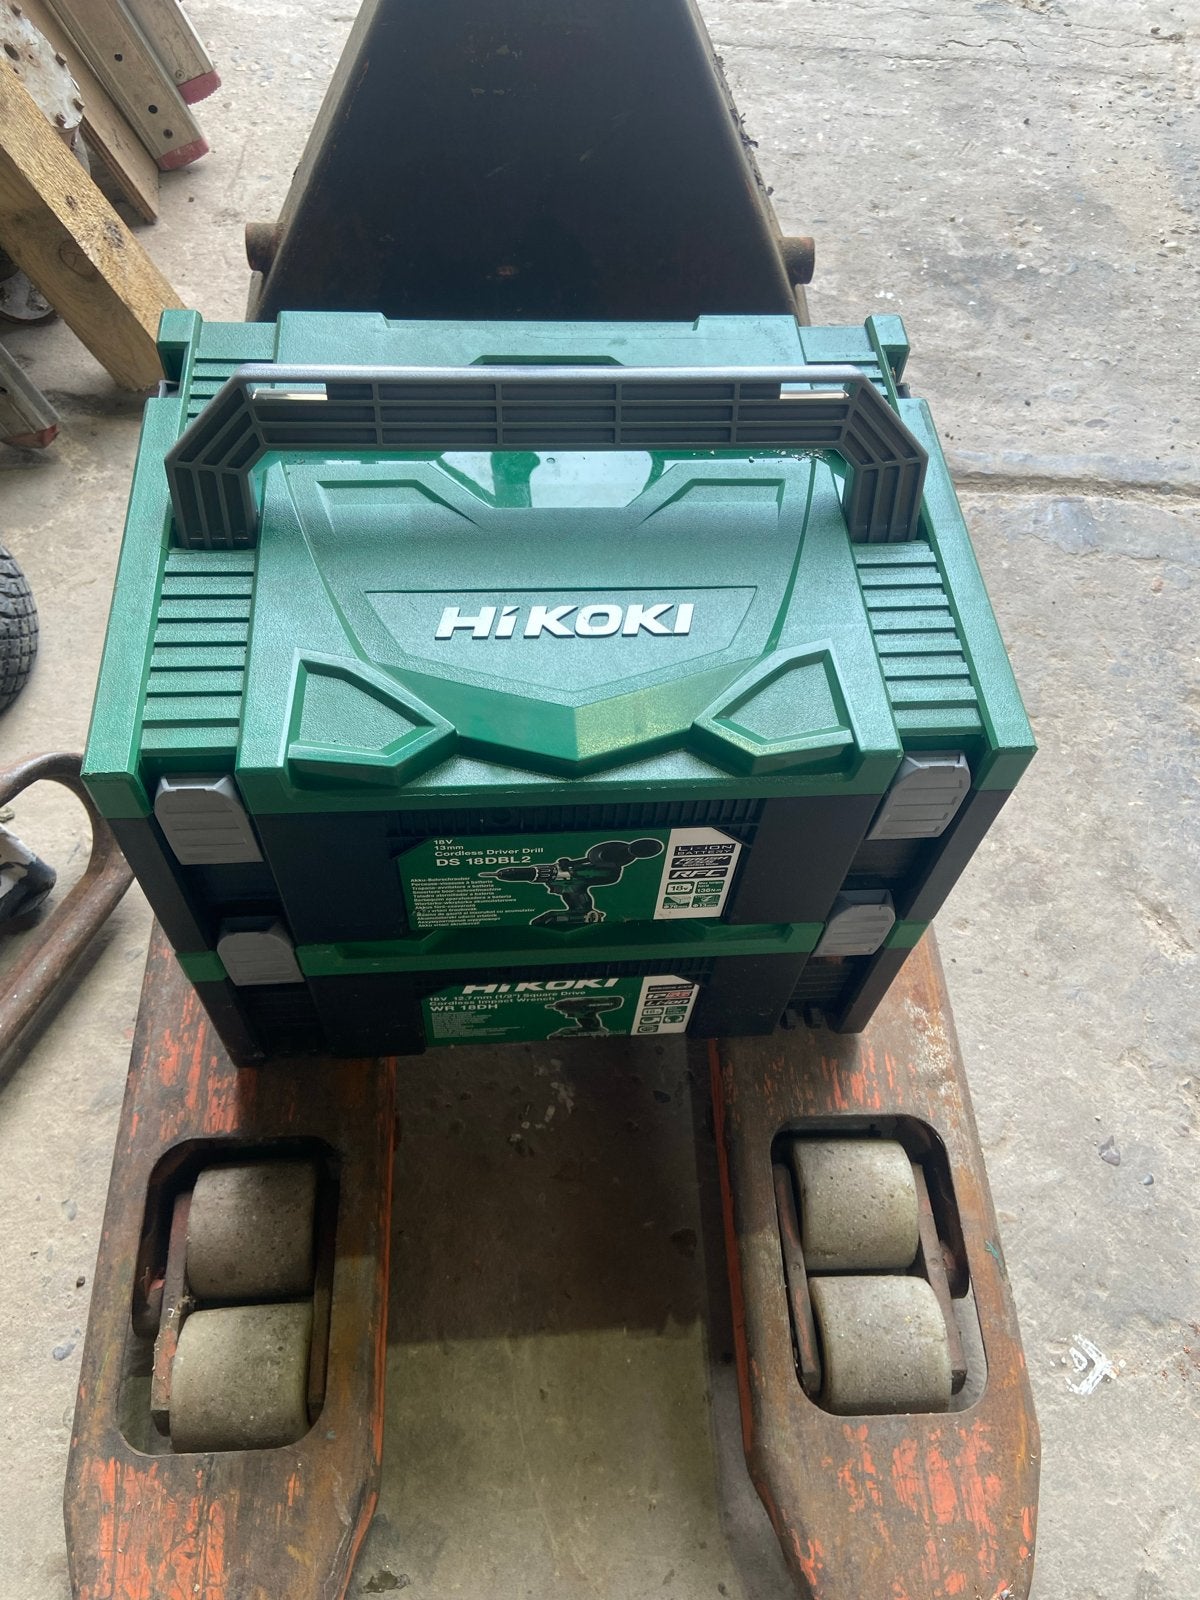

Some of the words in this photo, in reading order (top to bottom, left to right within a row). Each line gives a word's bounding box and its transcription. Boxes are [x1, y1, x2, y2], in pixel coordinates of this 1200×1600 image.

[435, 603, 695, 640] HiKOKI
[436, 858, 461, 867] DS
[466, 855, 531, 866] 18DBL2
[672, 869, 725, 878] RFC
